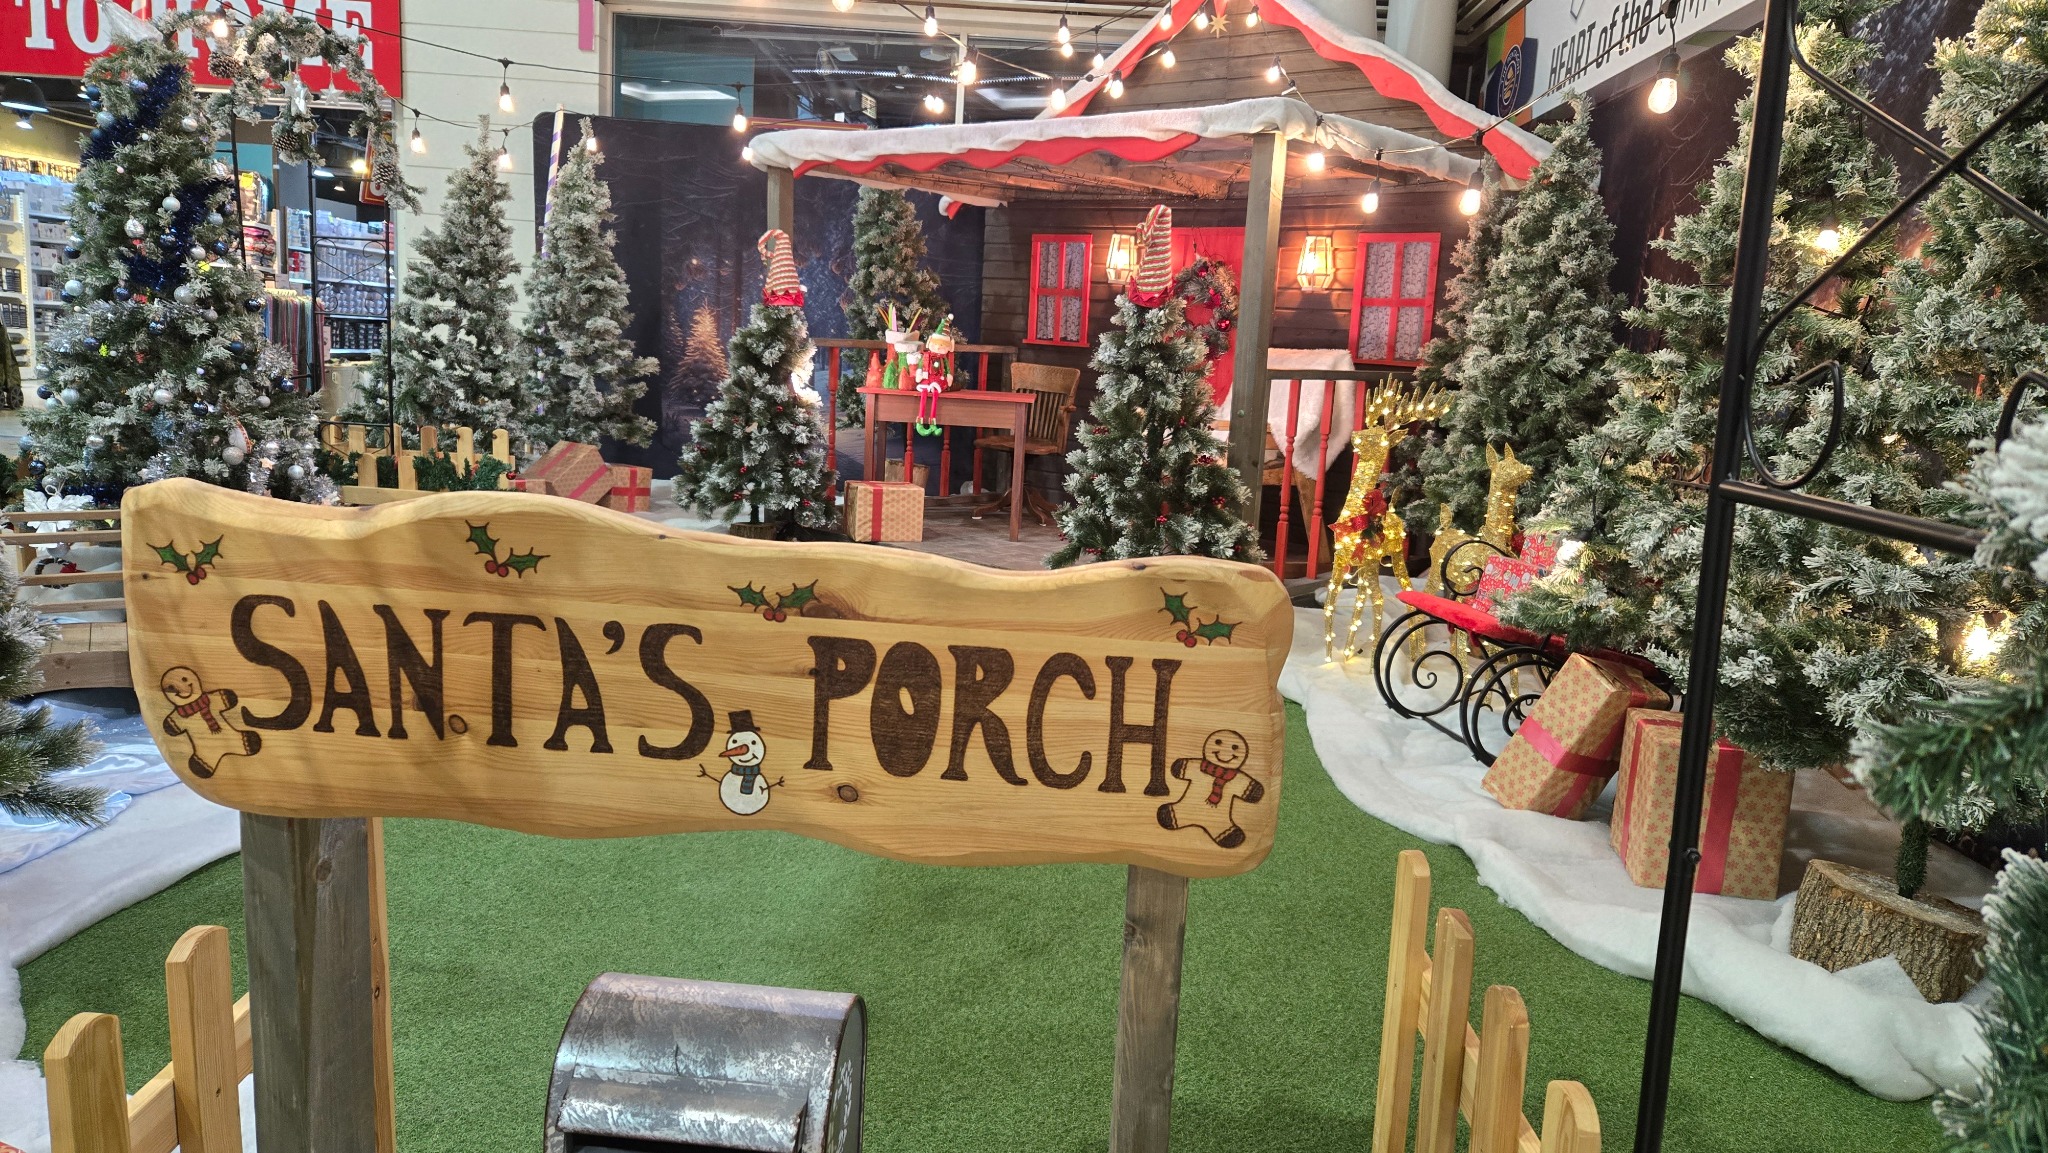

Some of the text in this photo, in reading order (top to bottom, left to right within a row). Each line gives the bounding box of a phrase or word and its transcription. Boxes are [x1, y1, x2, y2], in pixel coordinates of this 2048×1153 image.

[15, 0, 114, 54] TO
[1547, 21, 1597, 97] HEART
[1596, 5, 1621, 69] of
[1619, 0, 1654, 56] the
[230, 594, 1183, 797] SANTA'S PORCH
